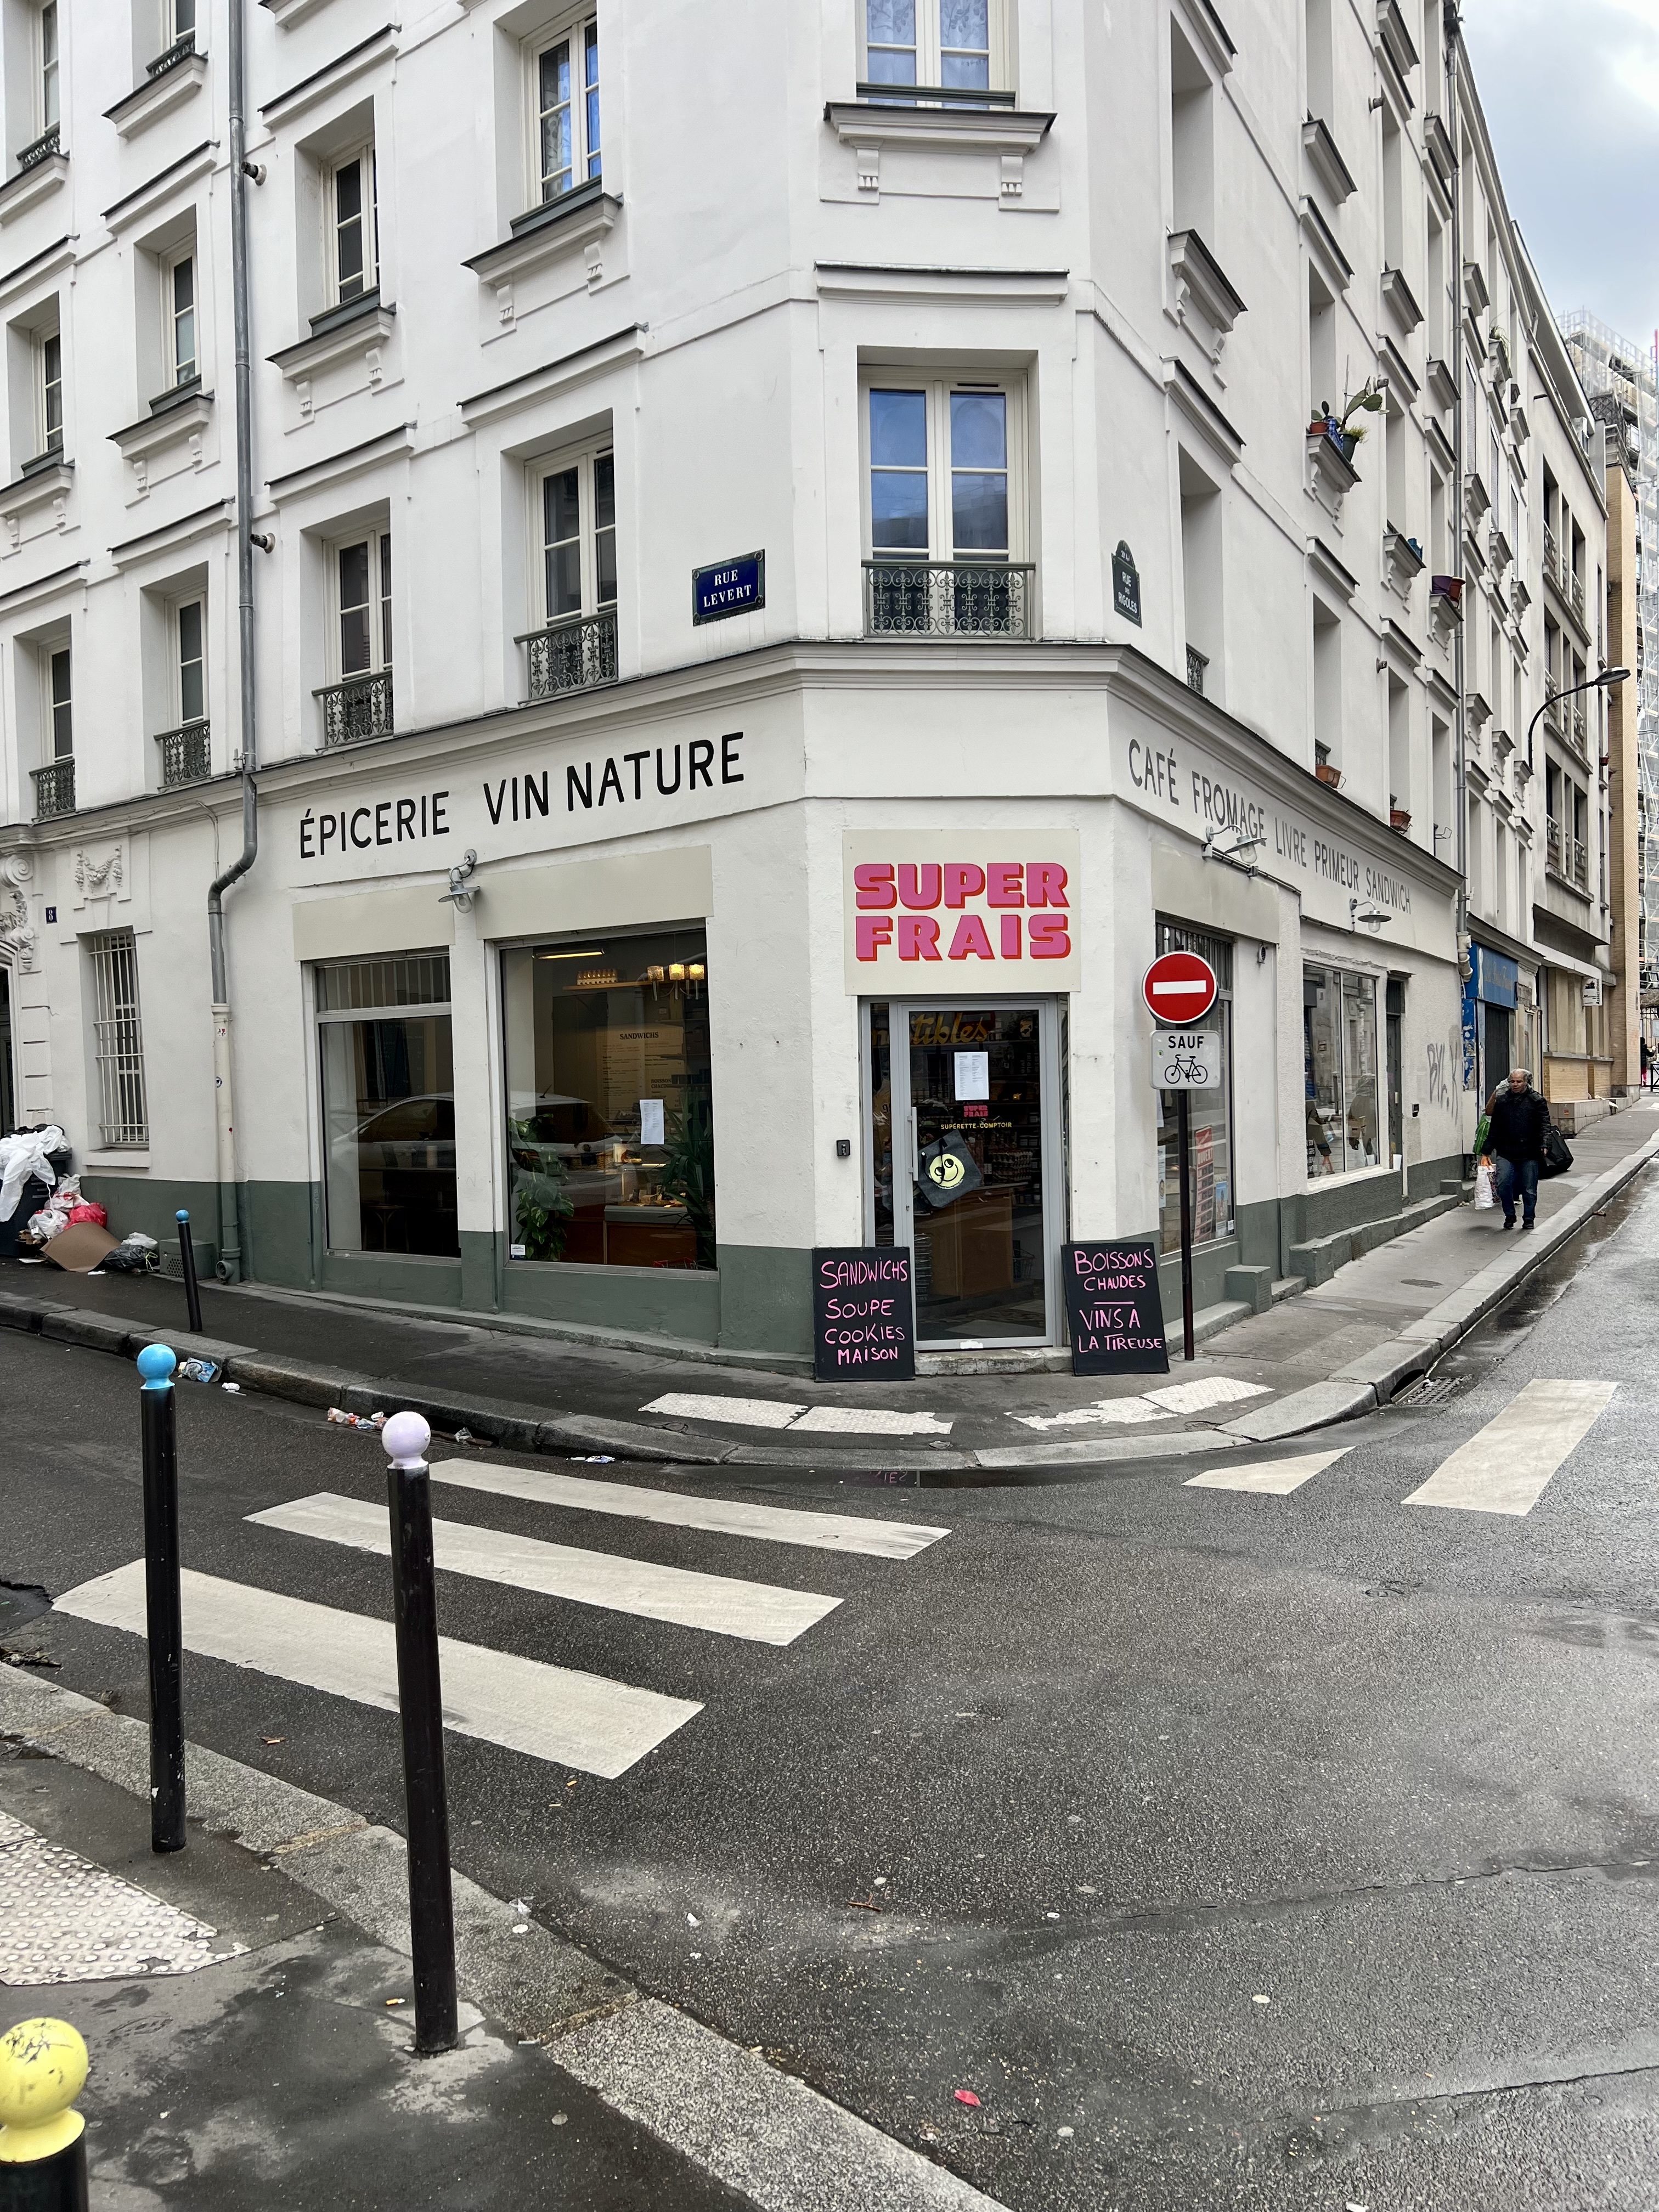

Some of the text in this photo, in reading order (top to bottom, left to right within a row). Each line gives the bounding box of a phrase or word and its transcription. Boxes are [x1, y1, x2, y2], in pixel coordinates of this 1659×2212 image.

[714, 569, 738, 586] RUE
[1122, 571, 1131, 586] RUE
[703, 584, 751, 608] LEVERT
[1118, 591, 1137, 613] RIGOLES
[300, 731, 744, 859] ÉPICERIE VIN NATURE
[1128, 738, 1411, 915] CAFÉ FROMAGE LIVRE PRIMEUR SANDWICH
[854, 862, 1070, 910] SUPER
[48, 909, 53, 921] 8
[855, 913, 1071, 962] FRAIS
[619, 1031, 659, 1040] SANDWICHS
[1167, 1035, 1204, 1049] SAUF
[1197, 1148, 1214, 1165] OUVERT
[820, 1256, 908, 1289] SANDWICHS
[1074, 1249, 1154, 1275] BOISSONS
[1084, 1274, 1146, 1291] CHAUDES
[825, 1298, 895, 1319] SOUPE
[1079, 1308, 1141, 1331] VINS A
[825, 1322, 905, 1344] COOKIES
[1078, 1333, 1163, 1353] LA TIREUSE
[837, 1345, 898, 1365] MAISON
